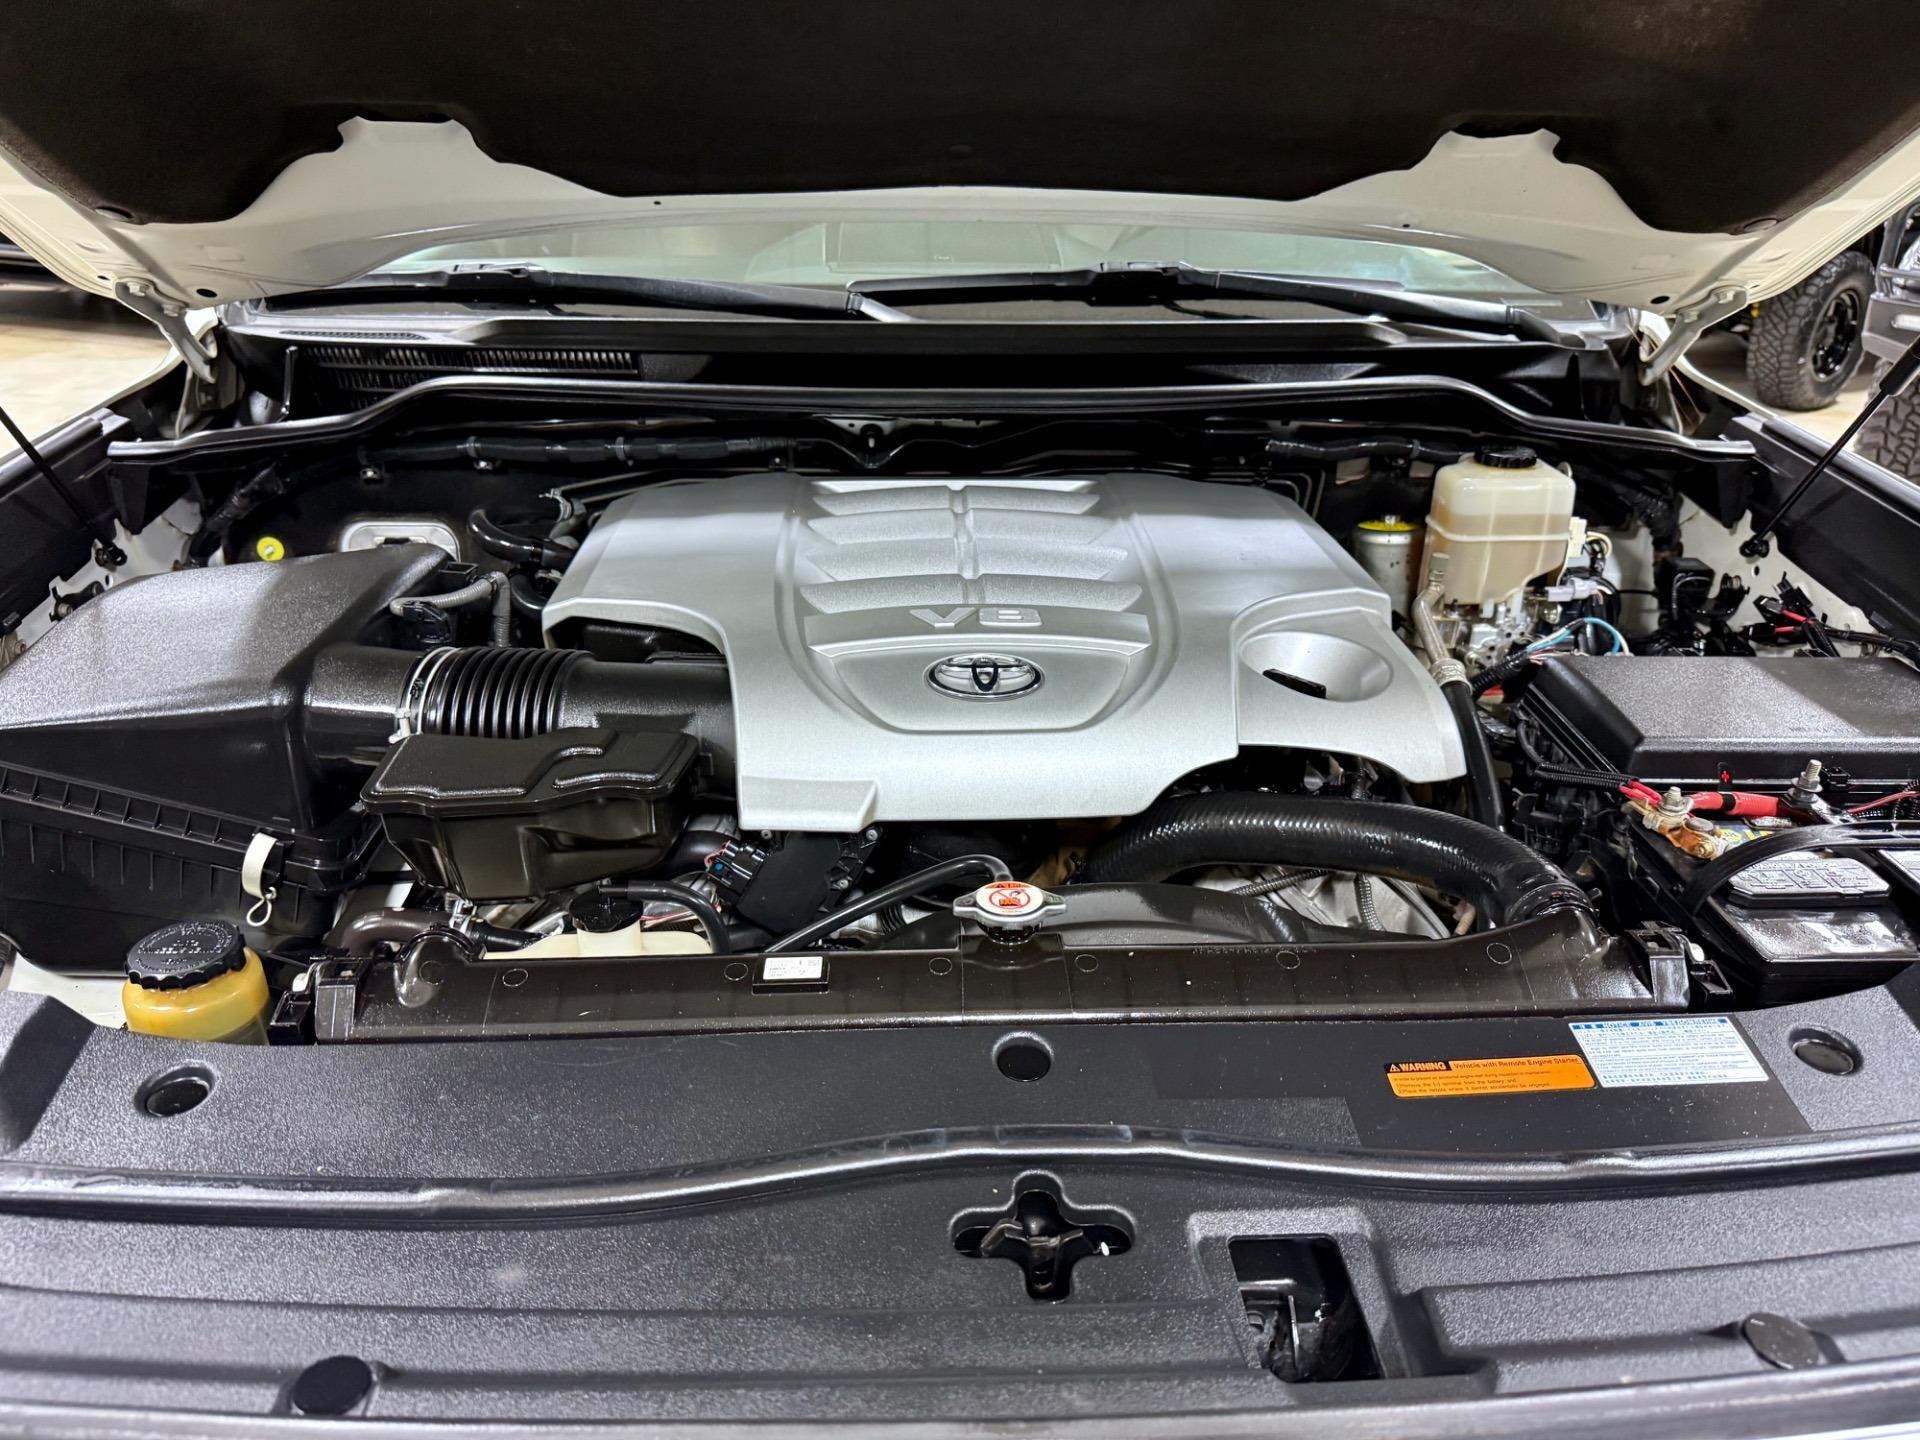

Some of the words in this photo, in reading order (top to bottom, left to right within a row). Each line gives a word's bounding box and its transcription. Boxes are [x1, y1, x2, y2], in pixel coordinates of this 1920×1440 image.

[909, 607, 1043, 628] V8
[1398, 1061, 1448, 1072] WARNING
[1453, 1061, 1482, 1069] Vehicle
[1483, 1060, 1498, 1068] with
[1527, 1058, 1553, 1066] Engine
